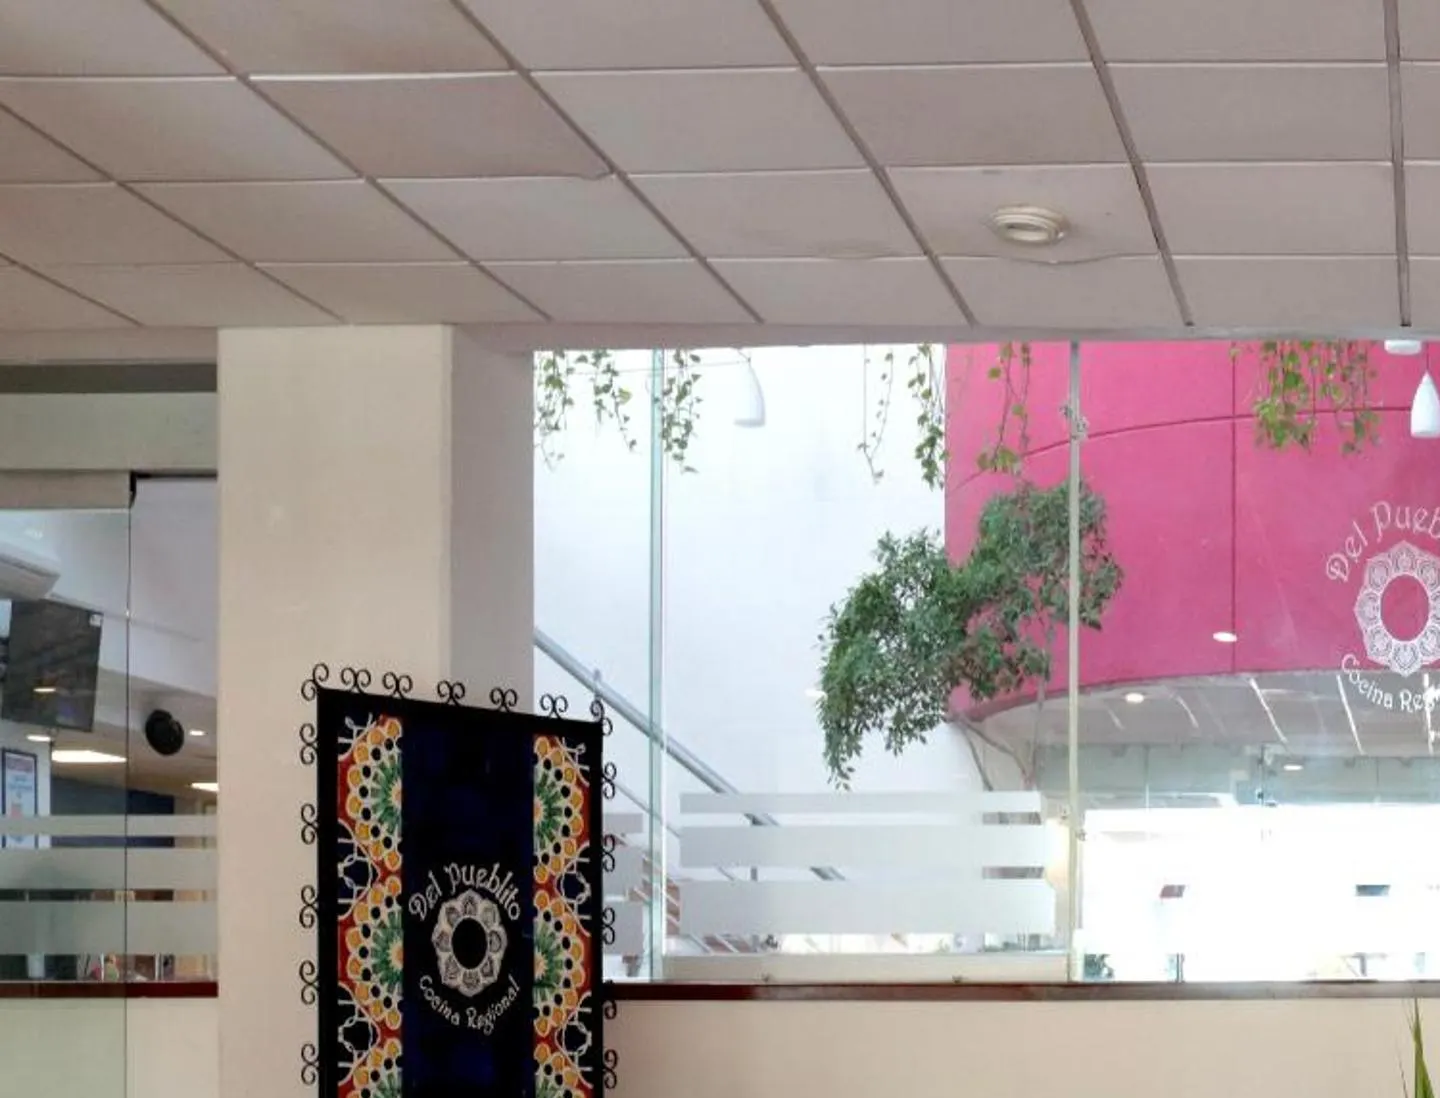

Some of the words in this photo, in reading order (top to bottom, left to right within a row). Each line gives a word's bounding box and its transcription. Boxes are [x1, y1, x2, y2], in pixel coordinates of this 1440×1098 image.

[1326, 521, 1368, 583] Del
[1341, 653, 1393, 710] Cocina
[408, 870, 442, 921] Del
[443, 862, 521, 921] Pueblito
[419, 975, 460, 1026] Cocina
[466, 974, 520, 1035] Regional
